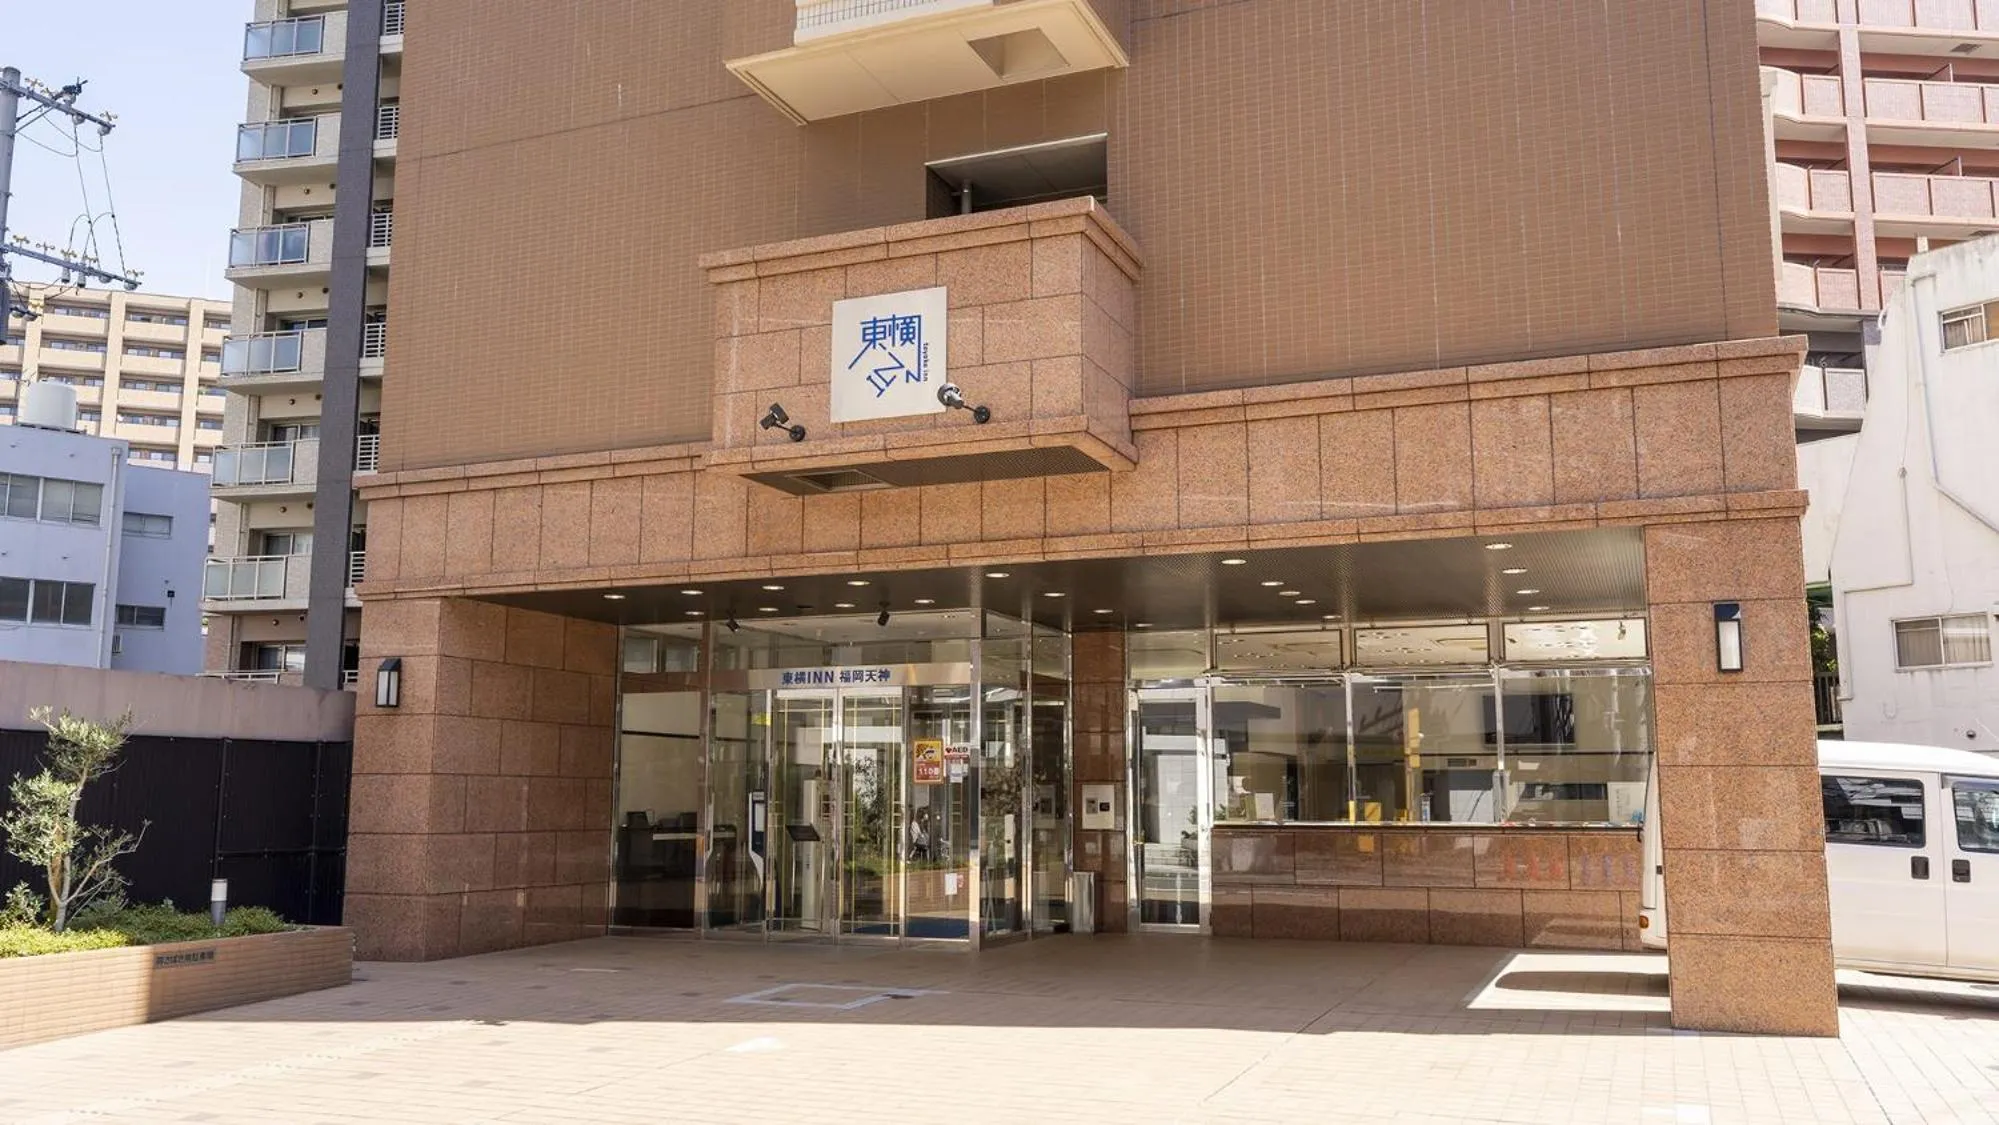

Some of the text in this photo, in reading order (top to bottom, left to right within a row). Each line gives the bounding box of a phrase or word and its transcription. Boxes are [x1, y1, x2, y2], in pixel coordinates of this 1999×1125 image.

[781, 669, 891, 685] 東横INN 福岡天神
